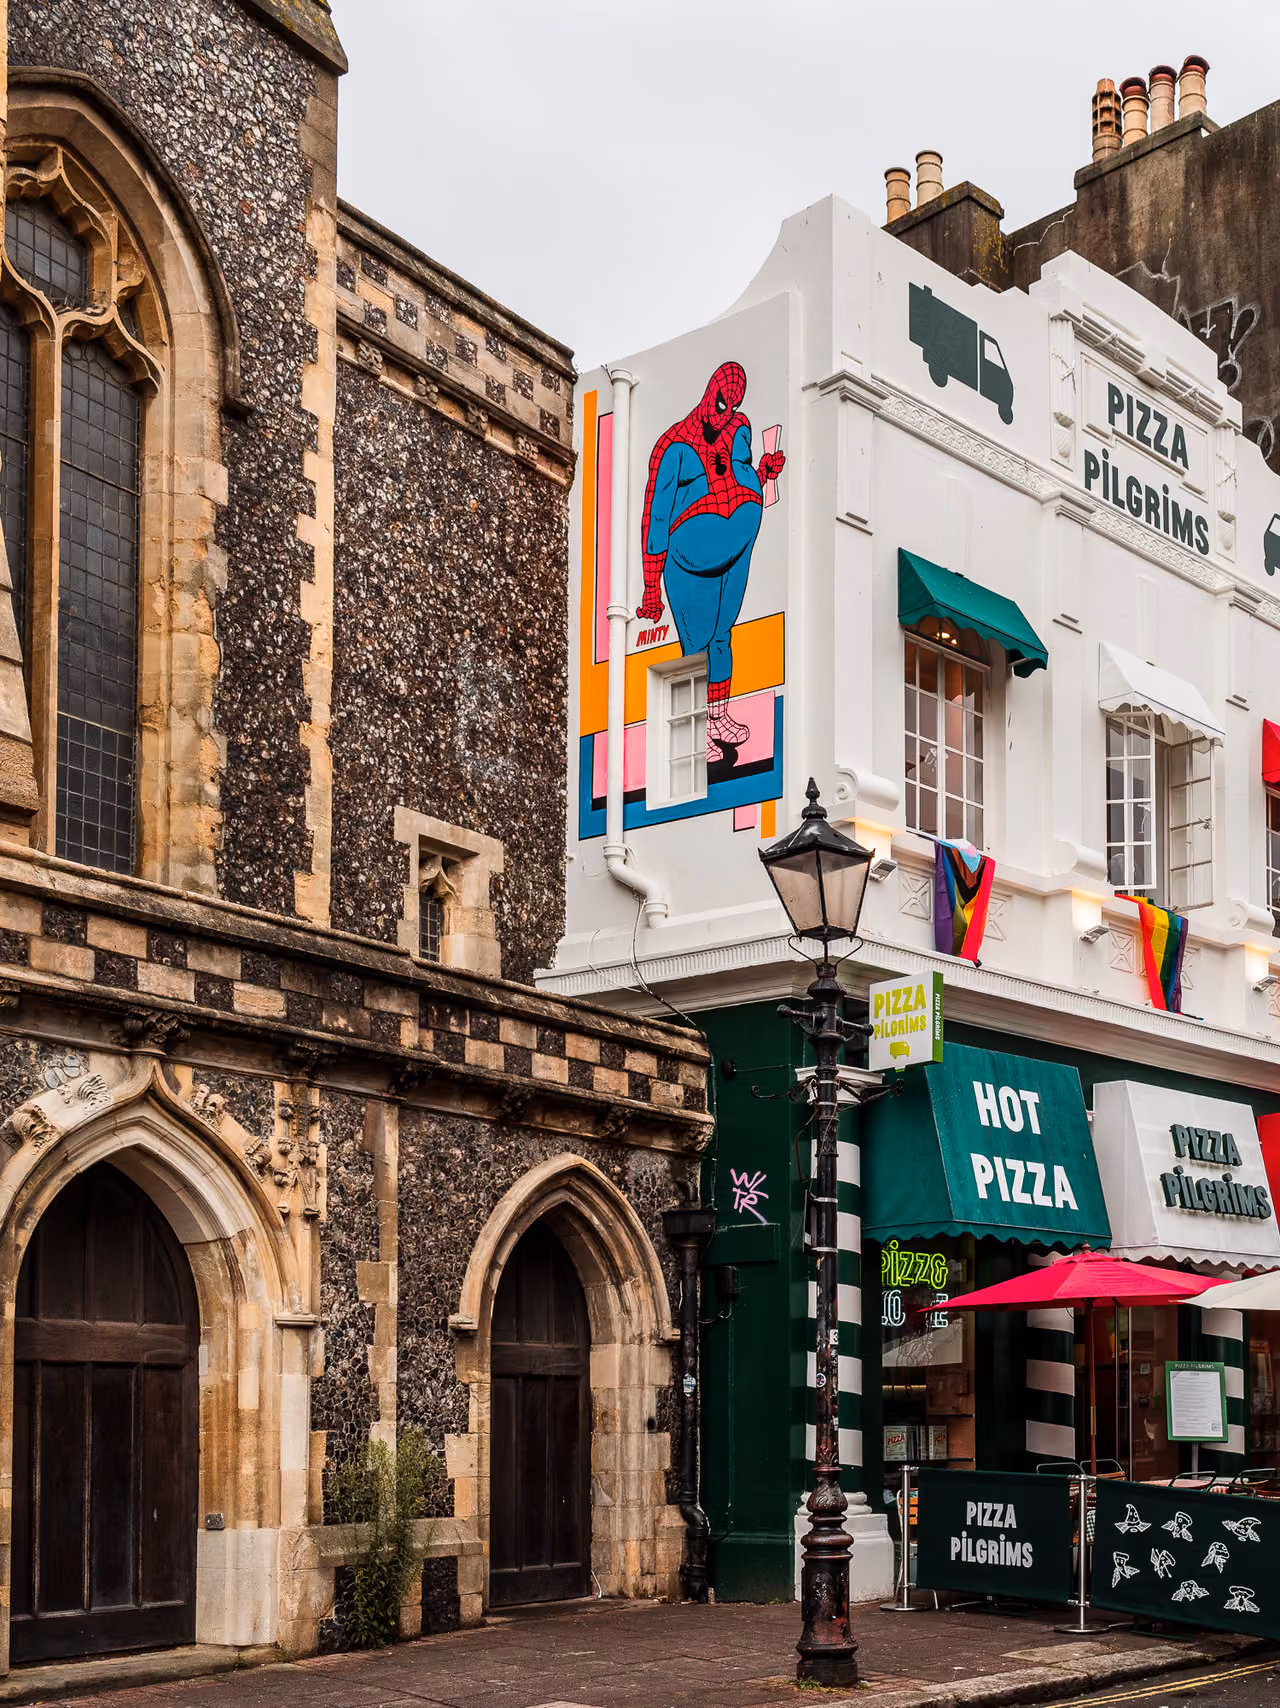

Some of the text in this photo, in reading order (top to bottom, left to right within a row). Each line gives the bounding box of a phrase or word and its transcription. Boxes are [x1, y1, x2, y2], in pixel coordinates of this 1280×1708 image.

[1107, 381, 1189, 470] PIZZA
[636, 624, 670, 647] MINTY
[874, 984, 927, 1018] PIZZA
[972, 1080, 1041, 1135] HOT
[1169, 1123, 1243, 1167] PIZZA
[970, 1152, 1079, 1211] PIZZA
[966, 1501, 1017, 1528] PIZZA
